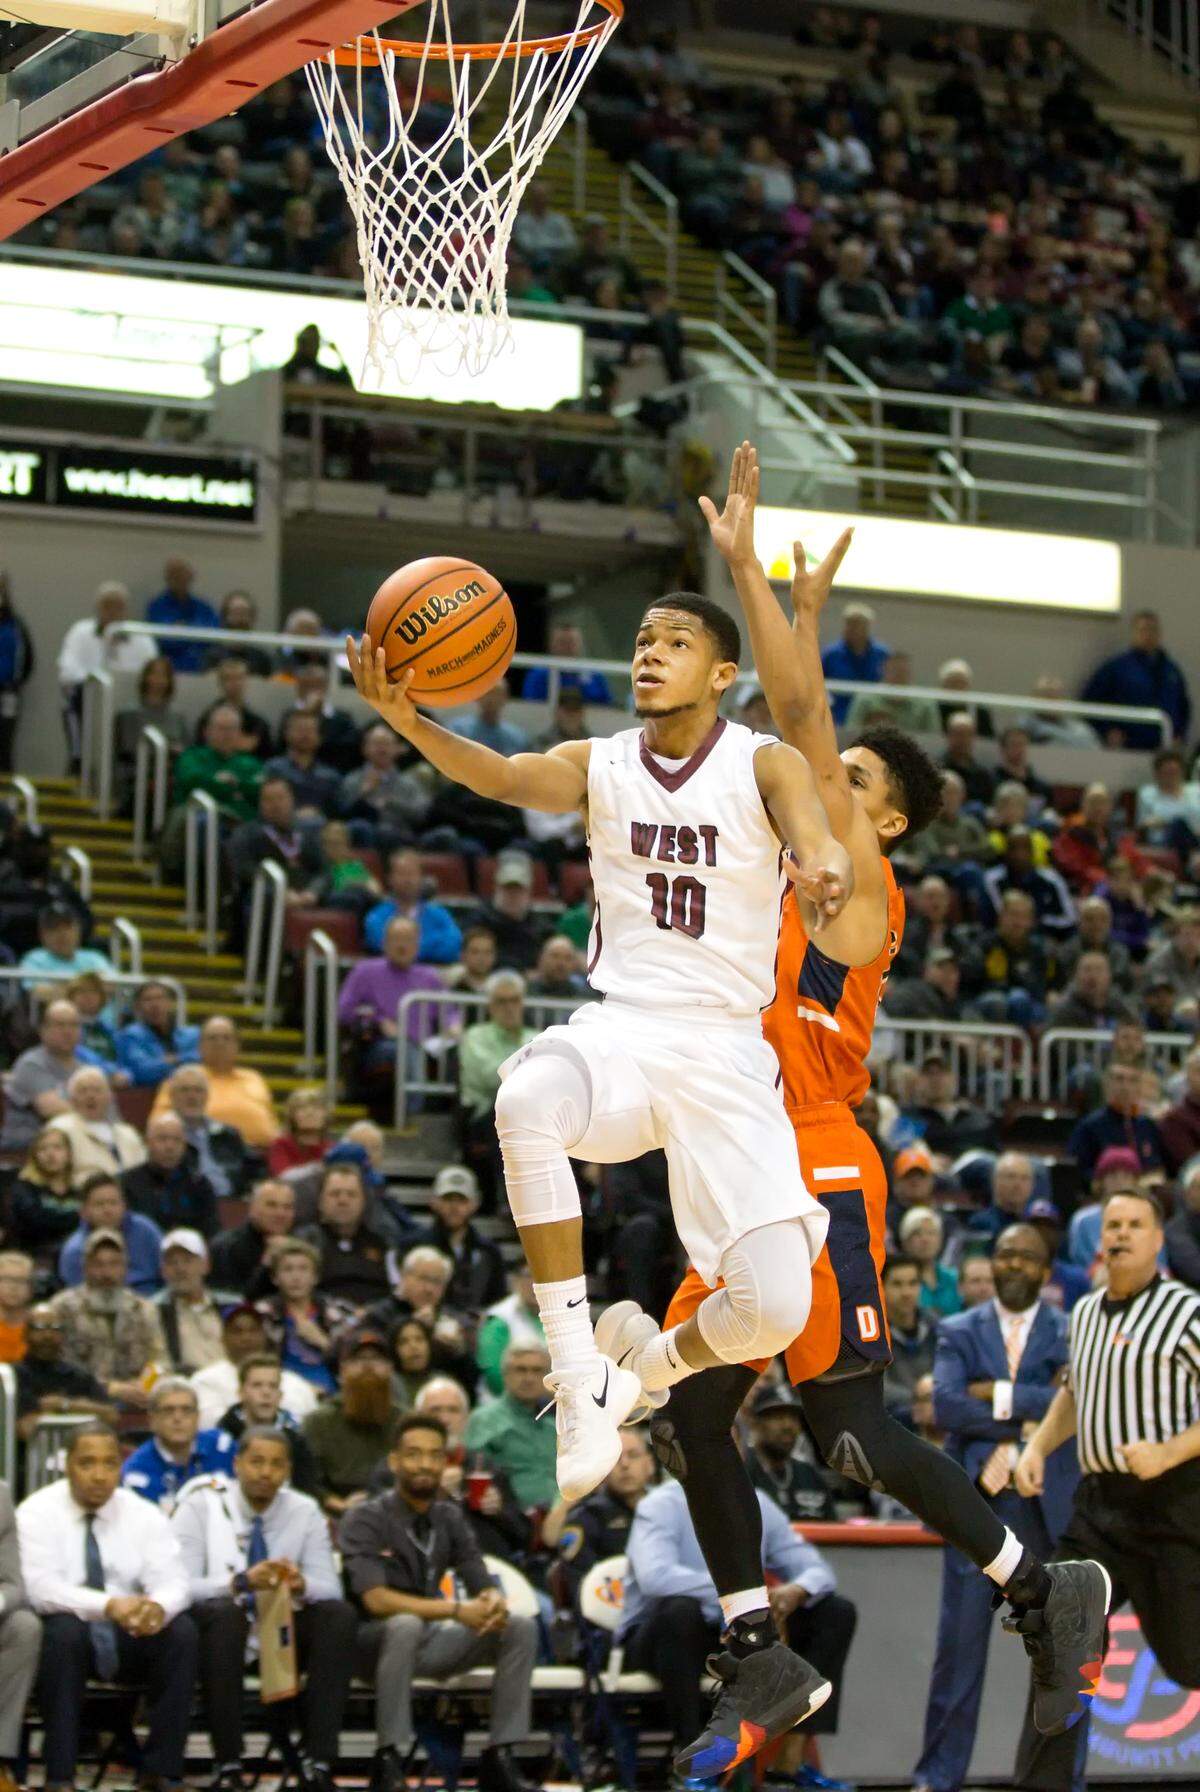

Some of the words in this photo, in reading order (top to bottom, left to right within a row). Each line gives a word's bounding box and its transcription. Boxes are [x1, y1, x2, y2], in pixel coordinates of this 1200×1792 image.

[394, 580, 487, 645] Wilson
[427, 655, 463, 678] MARCH
[474, 617, 507, 655] MADNESS
[631, 821, 719, 867] WEST
[646, 872, 707, 940] 10
